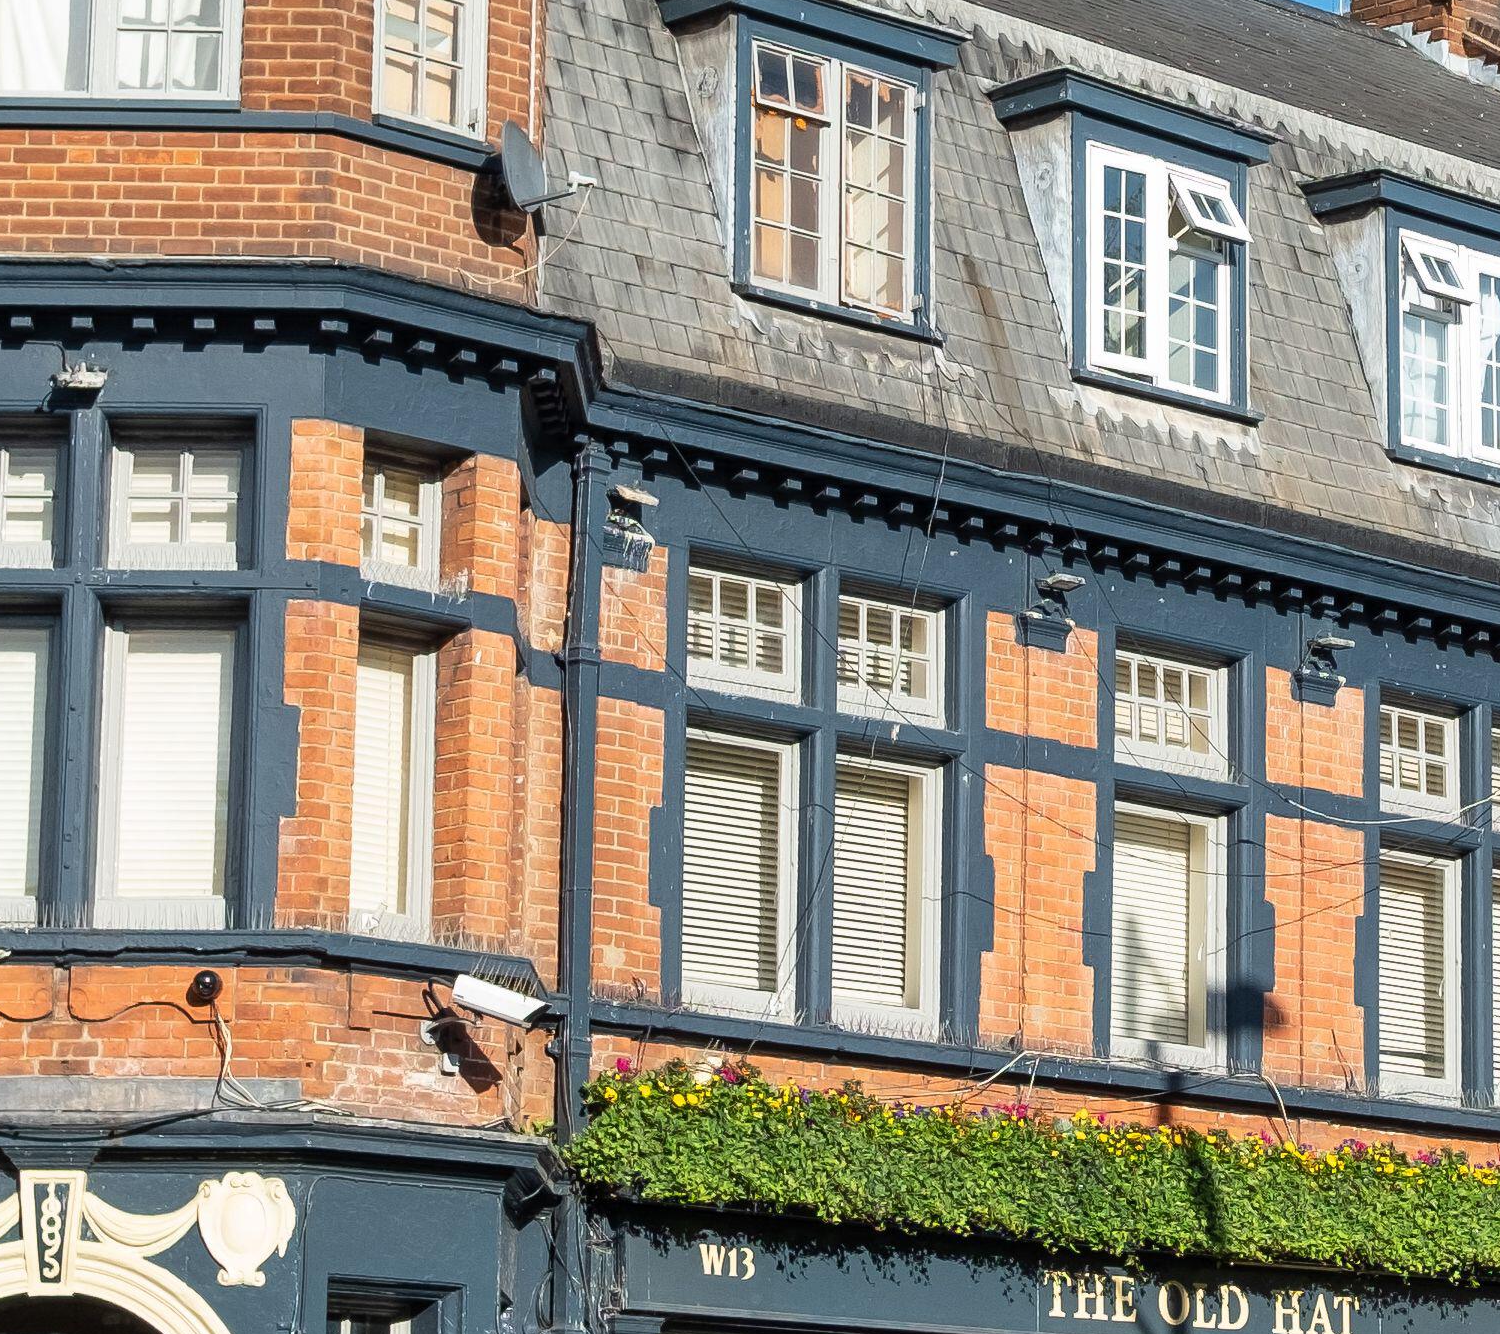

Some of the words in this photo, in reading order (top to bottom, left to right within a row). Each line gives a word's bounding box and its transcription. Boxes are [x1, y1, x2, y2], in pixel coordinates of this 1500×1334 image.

[699, 1243, 756, 1280] W13
[1043, 1269, 1138, 1323] THE
[1157, 1280, 1249, 1331] OLD
